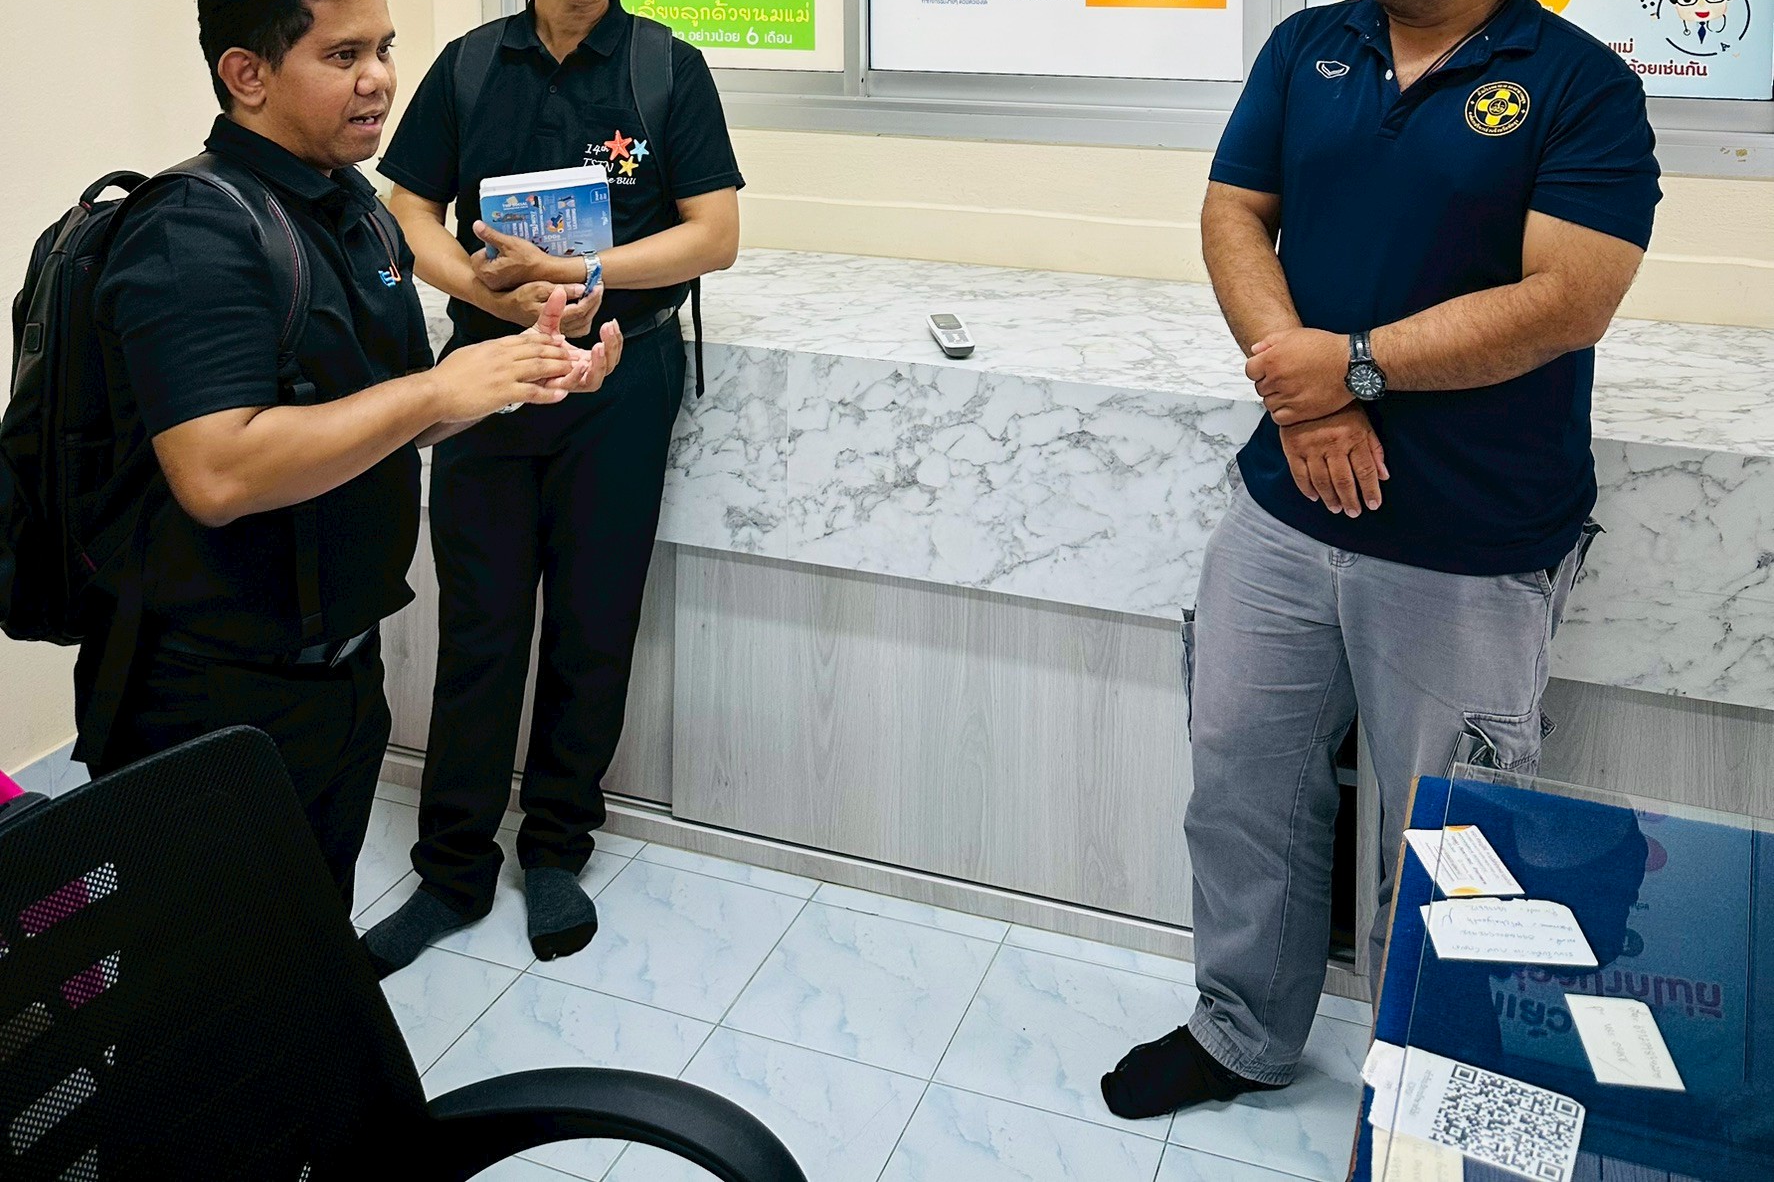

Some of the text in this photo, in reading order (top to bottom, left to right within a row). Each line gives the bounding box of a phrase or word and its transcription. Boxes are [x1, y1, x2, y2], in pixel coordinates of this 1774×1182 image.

[689, 29, 740, 42] อย่างน้อย
[746, 27, 759, 45] 6
[764, 31, 793, 44] เดือน
[1628, 59, 1708, 77] ด้วยเช่นกัน
